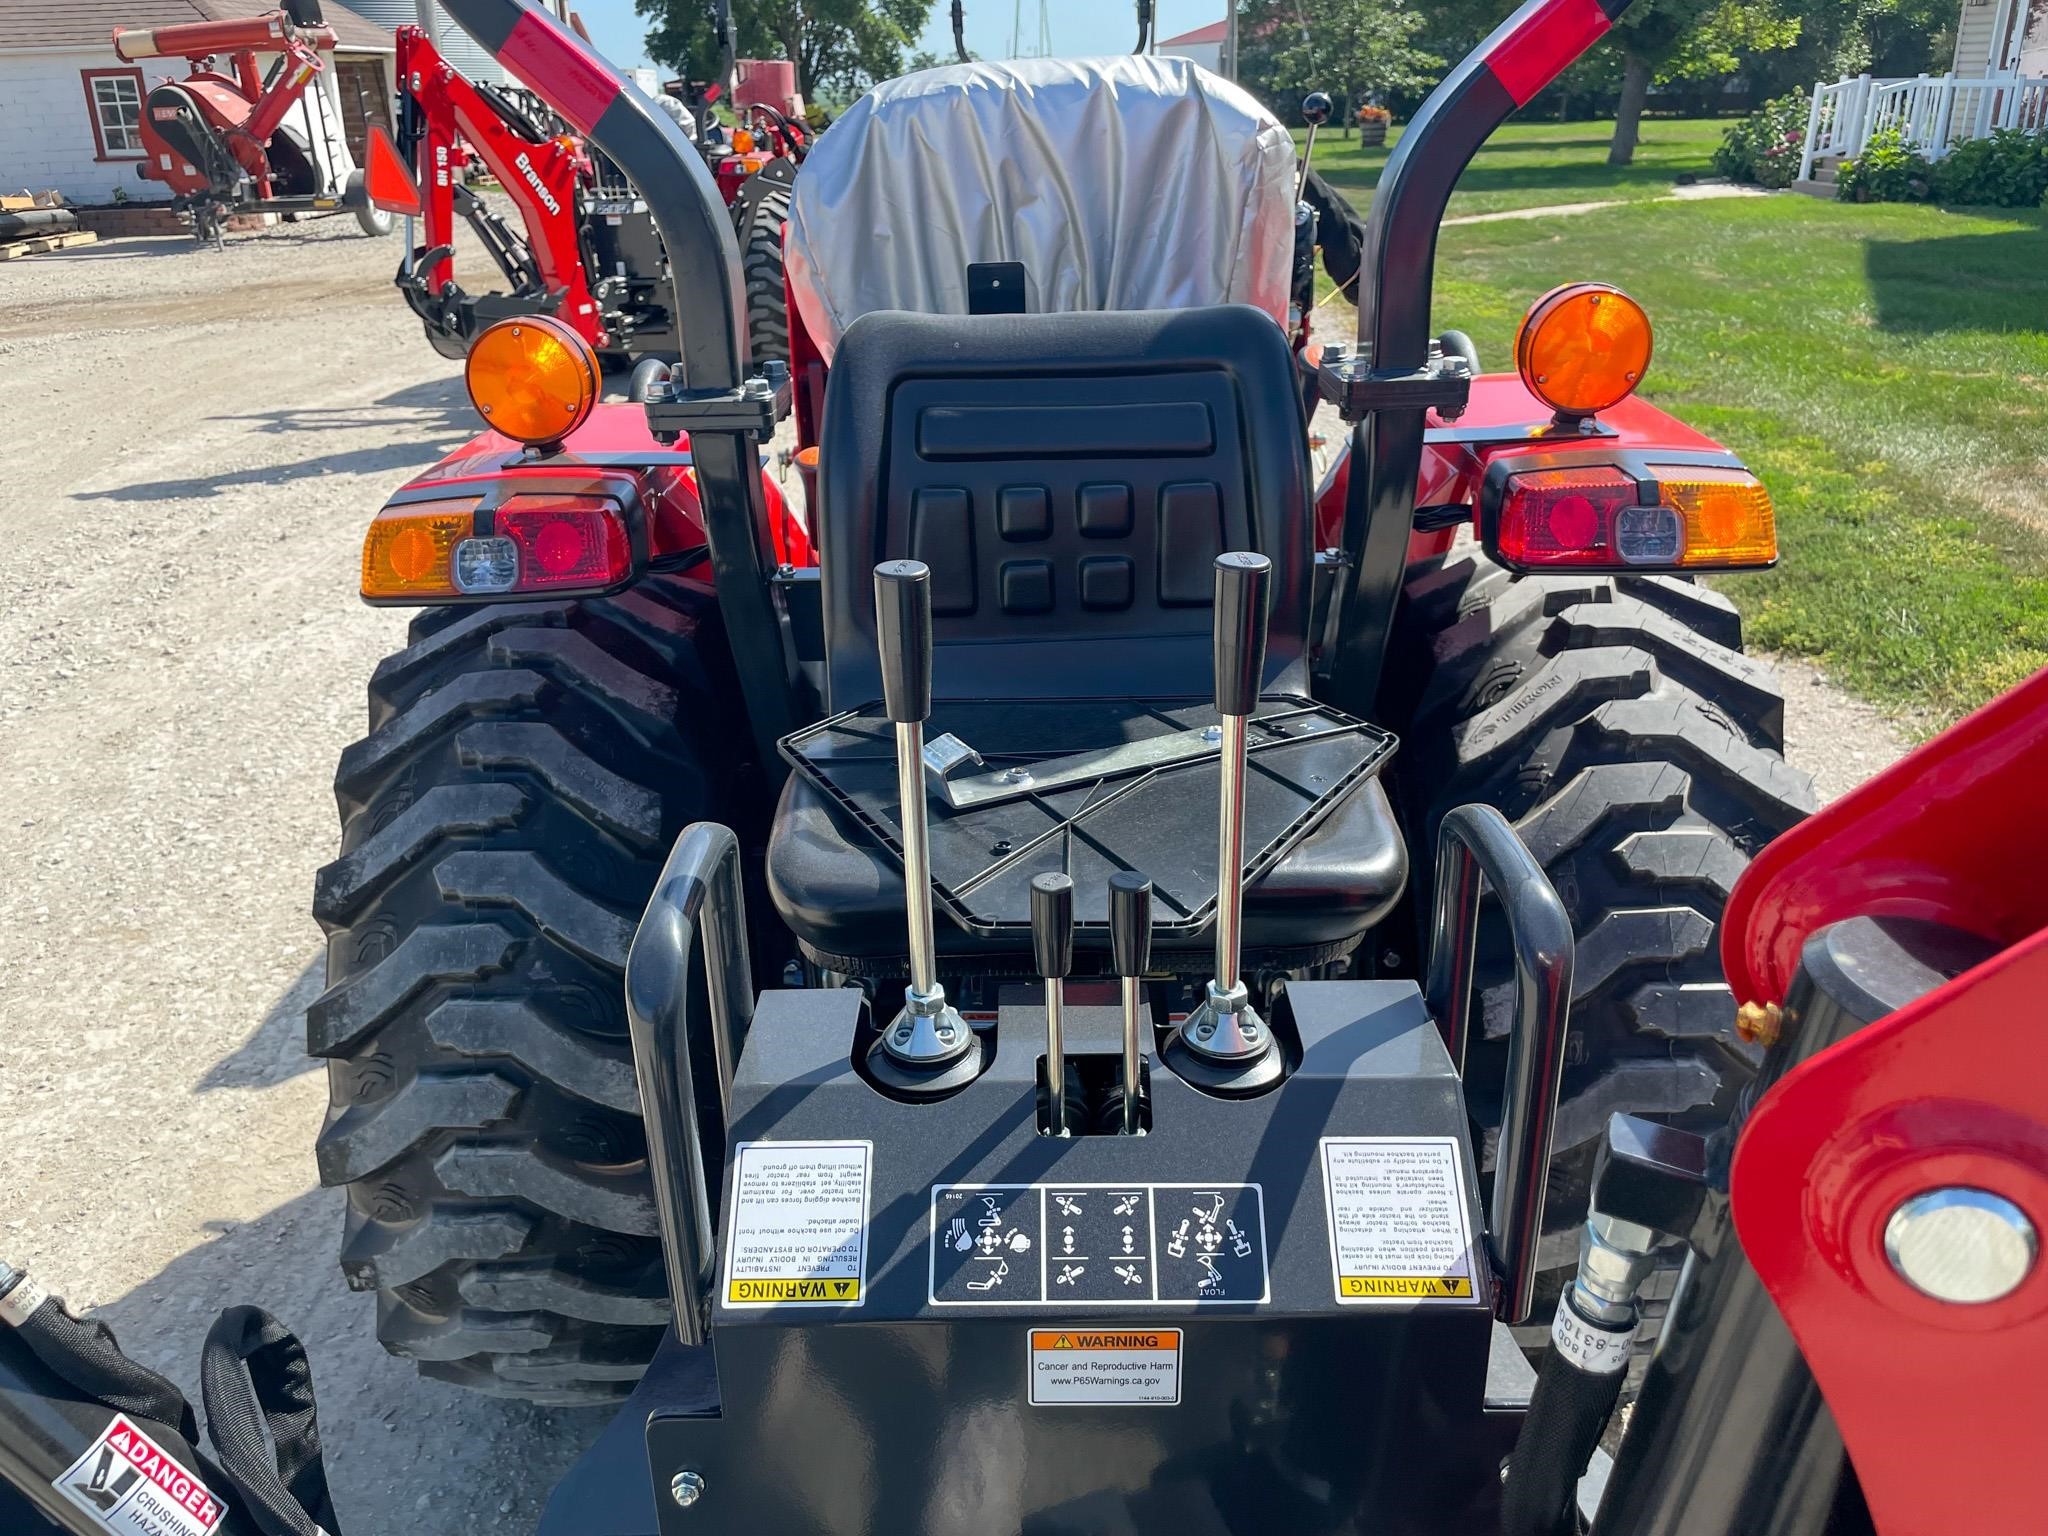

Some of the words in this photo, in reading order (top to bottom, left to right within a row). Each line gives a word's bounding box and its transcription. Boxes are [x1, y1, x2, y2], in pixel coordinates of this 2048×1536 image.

[436, 146, 447, 167] 150
[515, 152, 560, 216] Branson
[739, 1282, 826, 1297] WARNING
[1199, 1288, 1226, 1296] FLOAT
[1350, 1280, 1436, 1292] WARNING
[1077, 1336, 1158, 1347] WARNING
[1558, 1329, 1588, 1360] 1800
[1038, 1362, 1068, 1370] Cancer
[1072, 1362, 1087, 1370] and
[1091, 1362, 1146, 1371] Reproductive
[1150, 1362, 1173, 1370] Harm
[1051, 1377, 1160, 1386] www.P65Warnings.ca.gov
[128, 1440, 218, 1523] DANGER
[129, 1509, 170, 1536] HAZA
